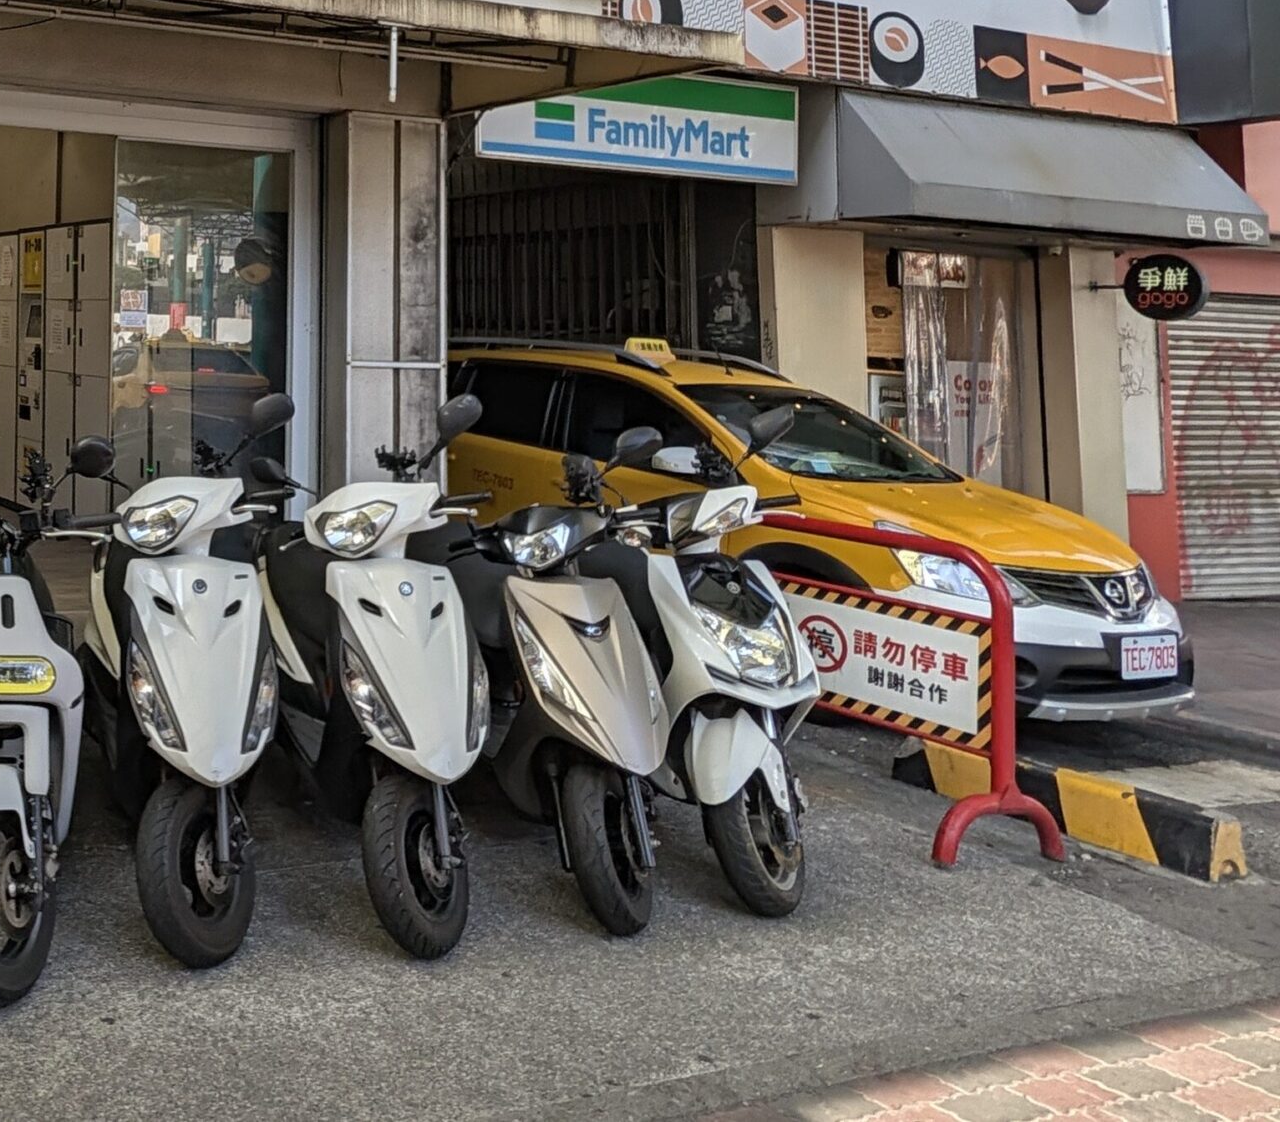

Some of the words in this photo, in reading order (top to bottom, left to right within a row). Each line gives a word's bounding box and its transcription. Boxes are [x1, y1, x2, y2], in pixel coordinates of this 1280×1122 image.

[587, 107, 752, 159] FamilyMart
[1137, 266, 1189, 291] 爭鮮
[1138, 292, 1189, 308] gogo
[853, 629, 970, 682] 請勿停車
[1123, 645, 1176, 672] TEC-7803
[867, 665, 949, 705] 謝謝合作
